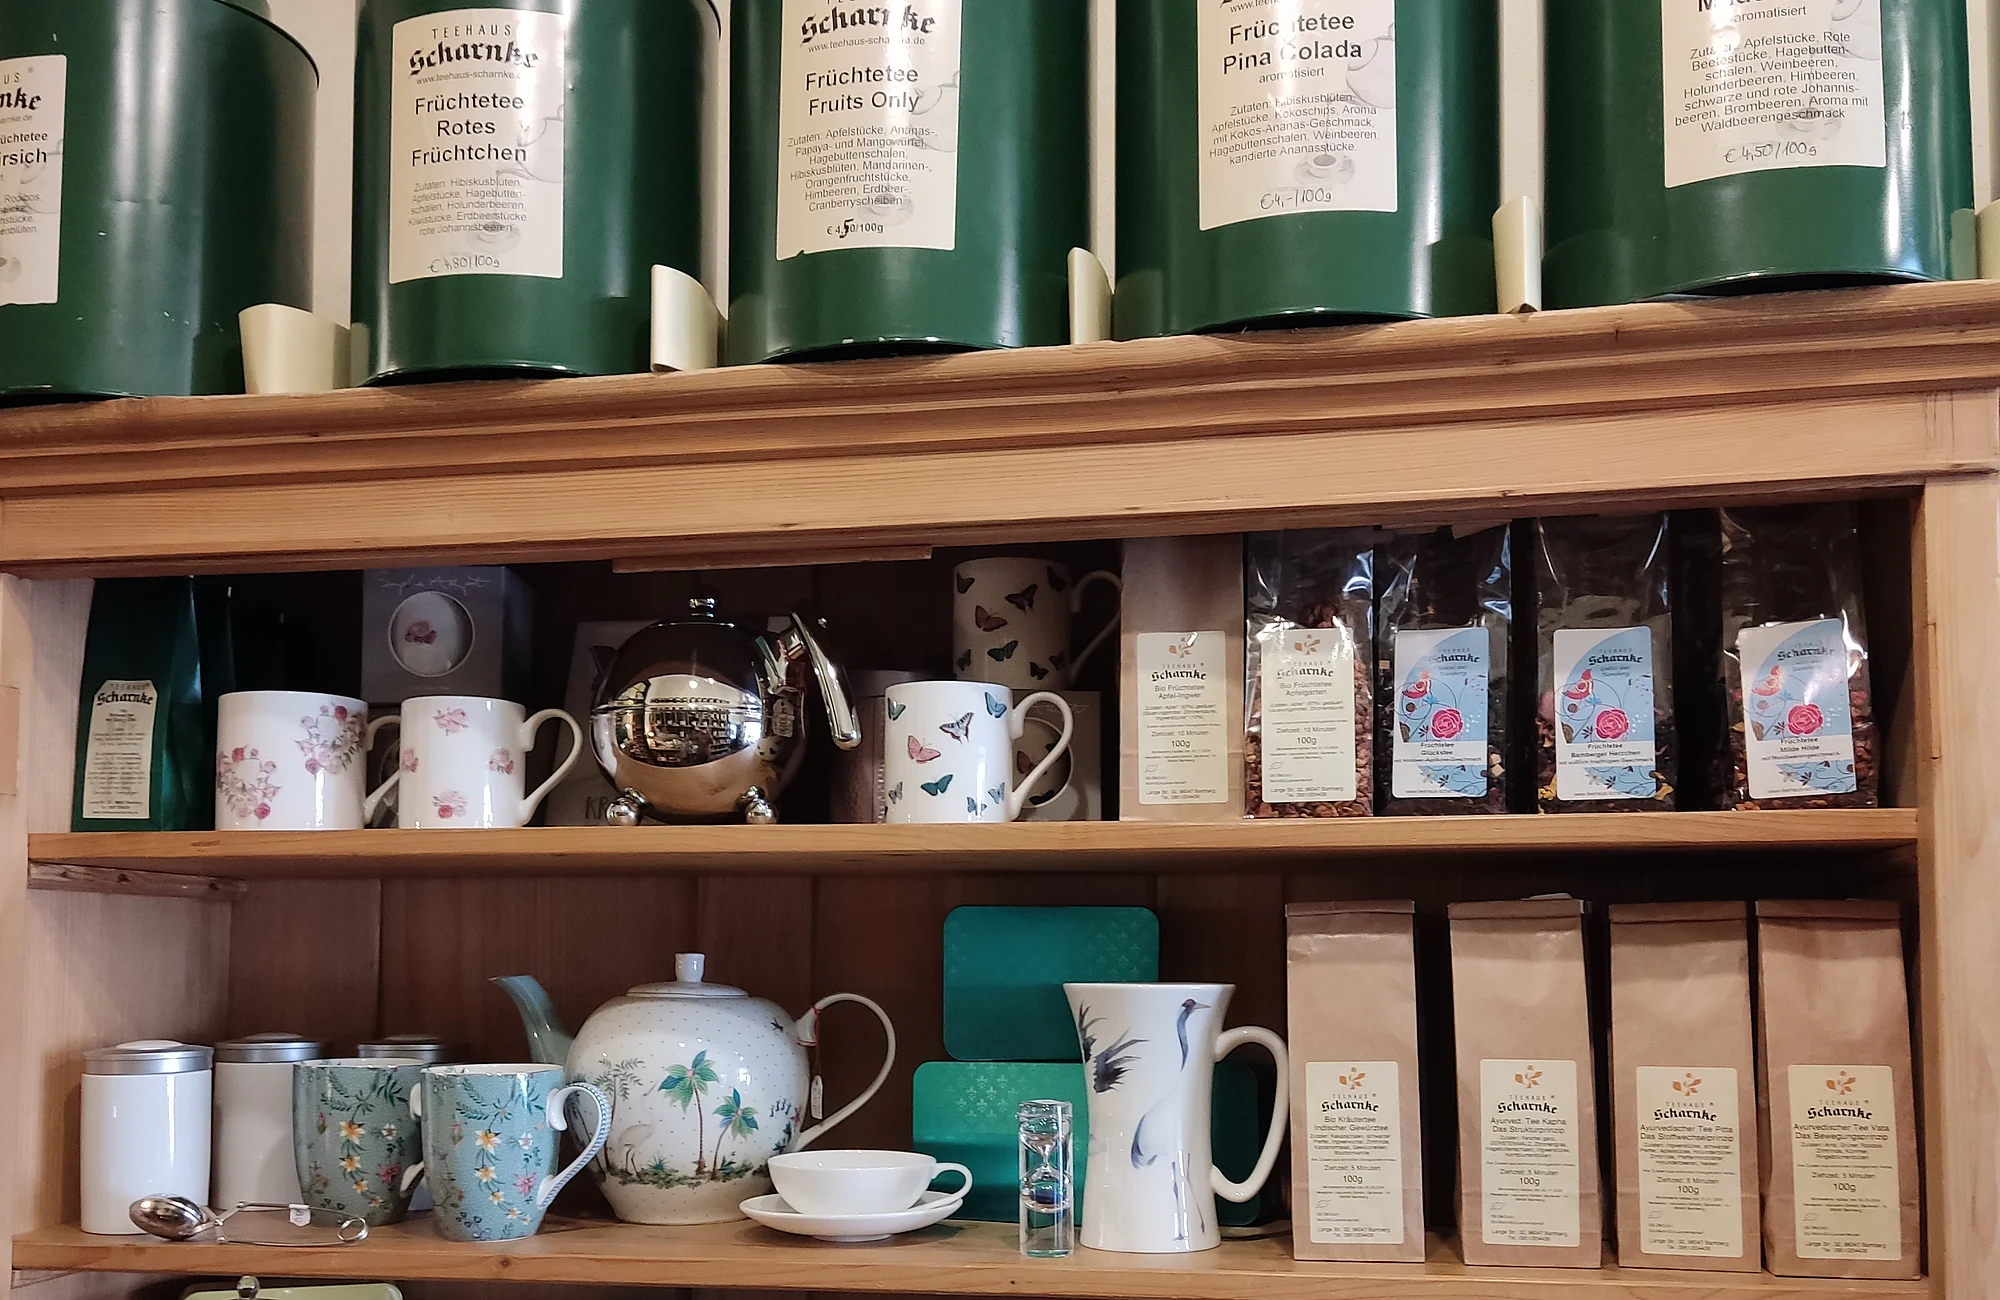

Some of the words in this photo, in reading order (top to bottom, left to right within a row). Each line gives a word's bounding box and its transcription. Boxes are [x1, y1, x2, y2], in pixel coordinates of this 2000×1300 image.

[1734, 6, 1807, 23] aromatisiert
[432, 25, 511, 39] TEEHAUS
[1230, 13, 1354, 45] Früctetee
[1744, 32, 1819, 49] Apfelstücke,
[1824, 32, 1850, 42] Rote
[1223, 51, 1272, 74] Pina
[1280, 40, 1362, 60] Colada
[1775, 45, 1850, 58] Hagebutten-
[409, 41, 538, 78] Scharnke
[1705, 64, 1756, 81] schalen,
[1760, 59, 1838, 72] Weinbeeren,
[806, 65, 918, 91] Früchtetee
[1684, 74, 1786, 99] Holunderbeeren,
[1791, 70, 1859, 81] Himbeeren,
[415, 93, 524, 115] Früchtetee
[809, 94, 863, 116] Fruits
[872, 92, 919, 112] Only
[1684, 94, 1742, 111] schwarze
[1746, 88, 1770, 99] und
[1774, 85, 1797, 95] rote
[1801, 83, 1859, 94] Johannis-
[1675, 109, 1720, 126] beeren,
[1724, 98, 1804, 115] Brombeeren,
[1808, 96, 1848, 107] Aroma
[1852, 96, 1868, 106] mit
[1212, 115, 1271, 133] Apfelstücke,
[1275, 106, 1338, 119] Kokoschips,
[1342, 105, 1377, 115] Aroma
[1700, 108, 1846, 132] Waldbeerengeschmack
[438, 120, 496, 137] Rotes
[788, 132, 822, 147] Zutaten:
[826, 126, 886, 140] Apfelstücke,
[1213, 135, 1227, 145] mit
[796, 143, 832, 156] Papaya-
[835, 138, 853, 148] und
[1209, 135, 1309, 158] Hagebuttenschalen,
[412, 144, 527, 167] Früchtchen
[1230, 149, 1276, 165] kandierte
[805, 172, 911, 189] Orangenfruchtstücke,
[805, 185, 859, 200] Himbeeren,
[809, 195, 903, 211] Cranberryscheiben
[419, 227, 435, 235] rote
[1429, 654, 1479, 664] charnke
[1589, 654, 1643, 665] Scharnke
[1778, 646, 1834, 661] Scharnke
[1151, 669, 1207, 682] Scharnke
[1277, 667, 1334, 679] Scharnke
[97, 692, 153, 705] Scharnke
[1172, 740, 1190, 748] 100g
[1297, 737, 1317, 745] 100g
[1322, 1100, 1379, 1112] Scharnke
[1498, 1101, 1558, 1113] Scharnke
[1808, 1106, 1872, 1119] Scharnke
[1654, 1108, 1717, 1121] Scharnke
[1658, 1133, 1734, 1141] Stoffwechselprinzip
[1814, 1132, 1888, 1141] Bewegungsprinzip
[1343, 1175, 1362, 1184] 100g
[1520, 1177, 1540, 1186] 100g
[1678, 1186, 1699, 1195] 100g
[1833, 1183, 1856, 1192] 100g
